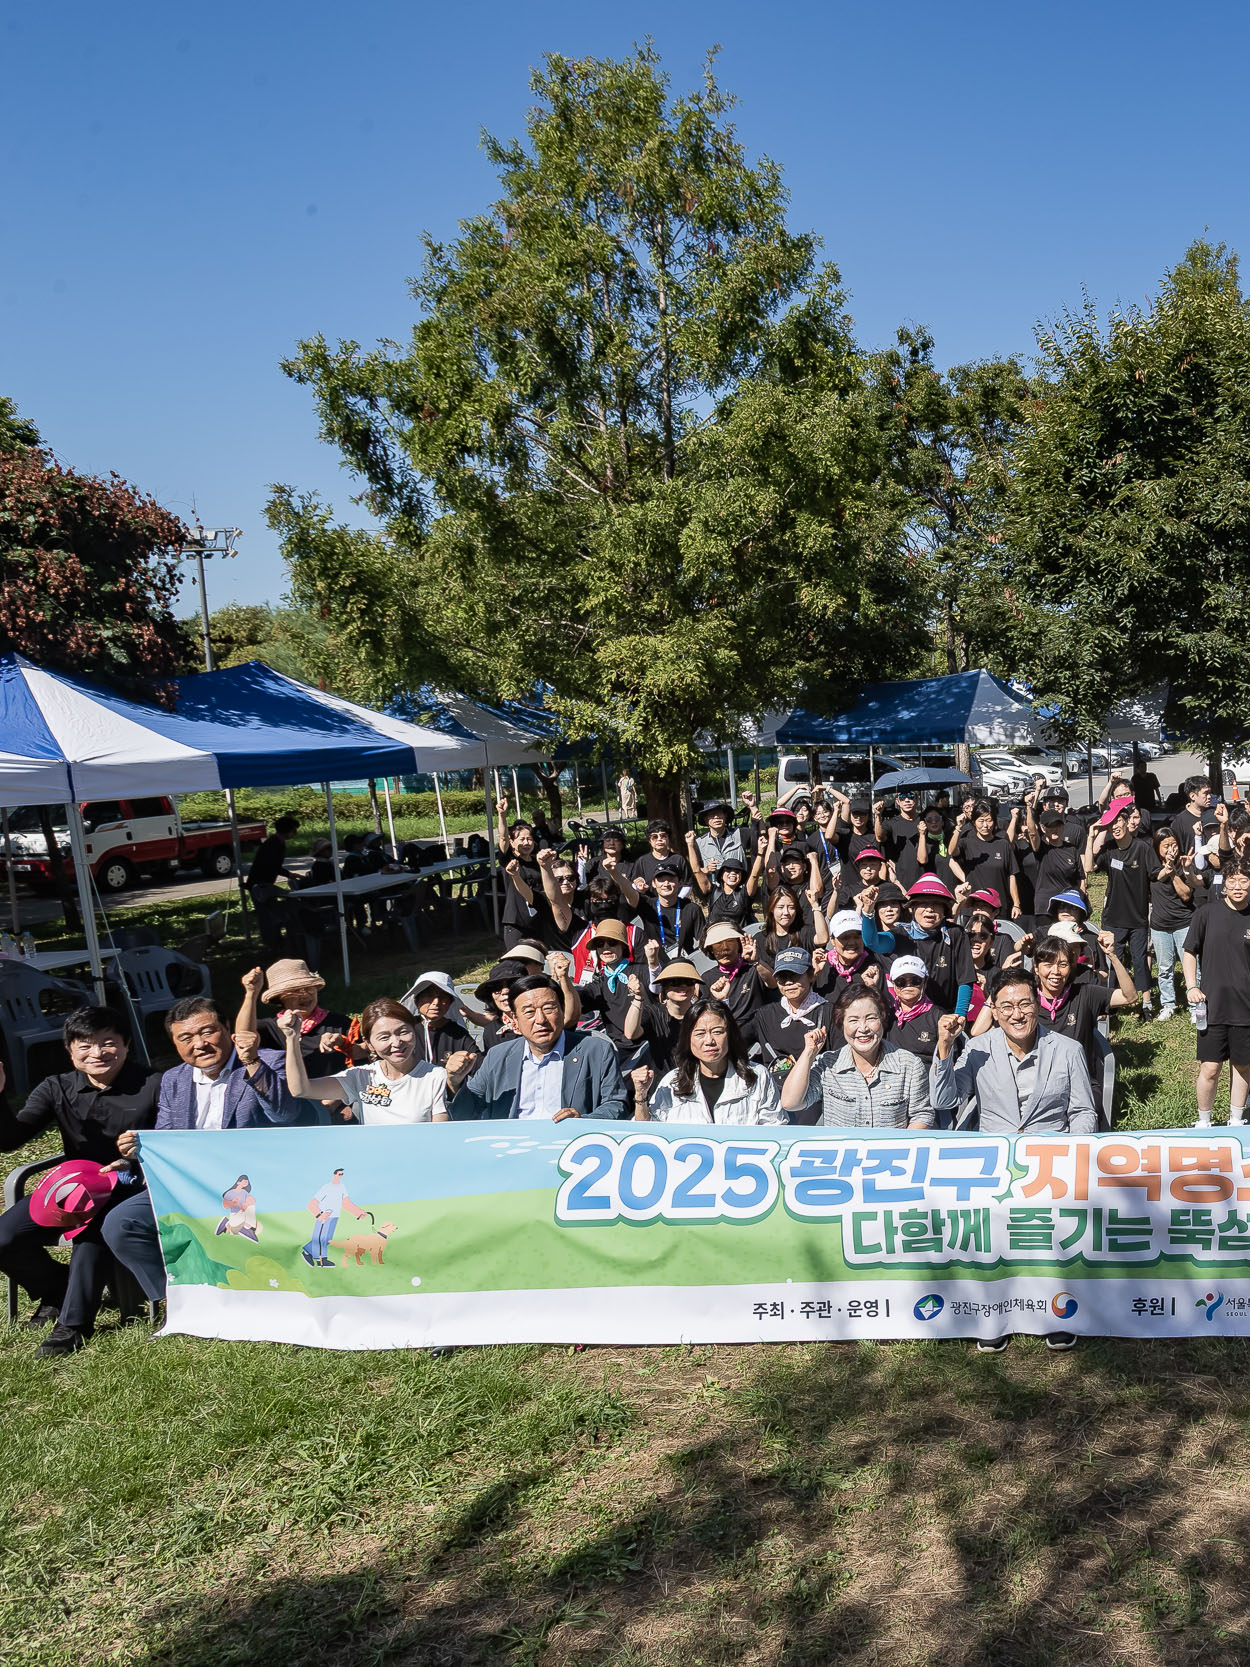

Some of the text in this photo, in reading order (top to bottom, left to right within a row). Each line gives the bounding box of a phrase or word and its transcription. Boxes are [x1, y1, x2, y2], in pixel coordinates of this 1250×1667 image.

[567, 1142, 768, 1210] 2025
[790, 1145, 1001, 1205] 광진구
[852, 1208, 991, 1255] 다함께
[1006, 1207, 1154, 1252] 즐기는
[752, 1299, 880, 1320] 주최 주관 운영
[950, 1297, 1047, 1317] 광진구장애인체육회
[1131, 1297, 1167, 1316] 후원
